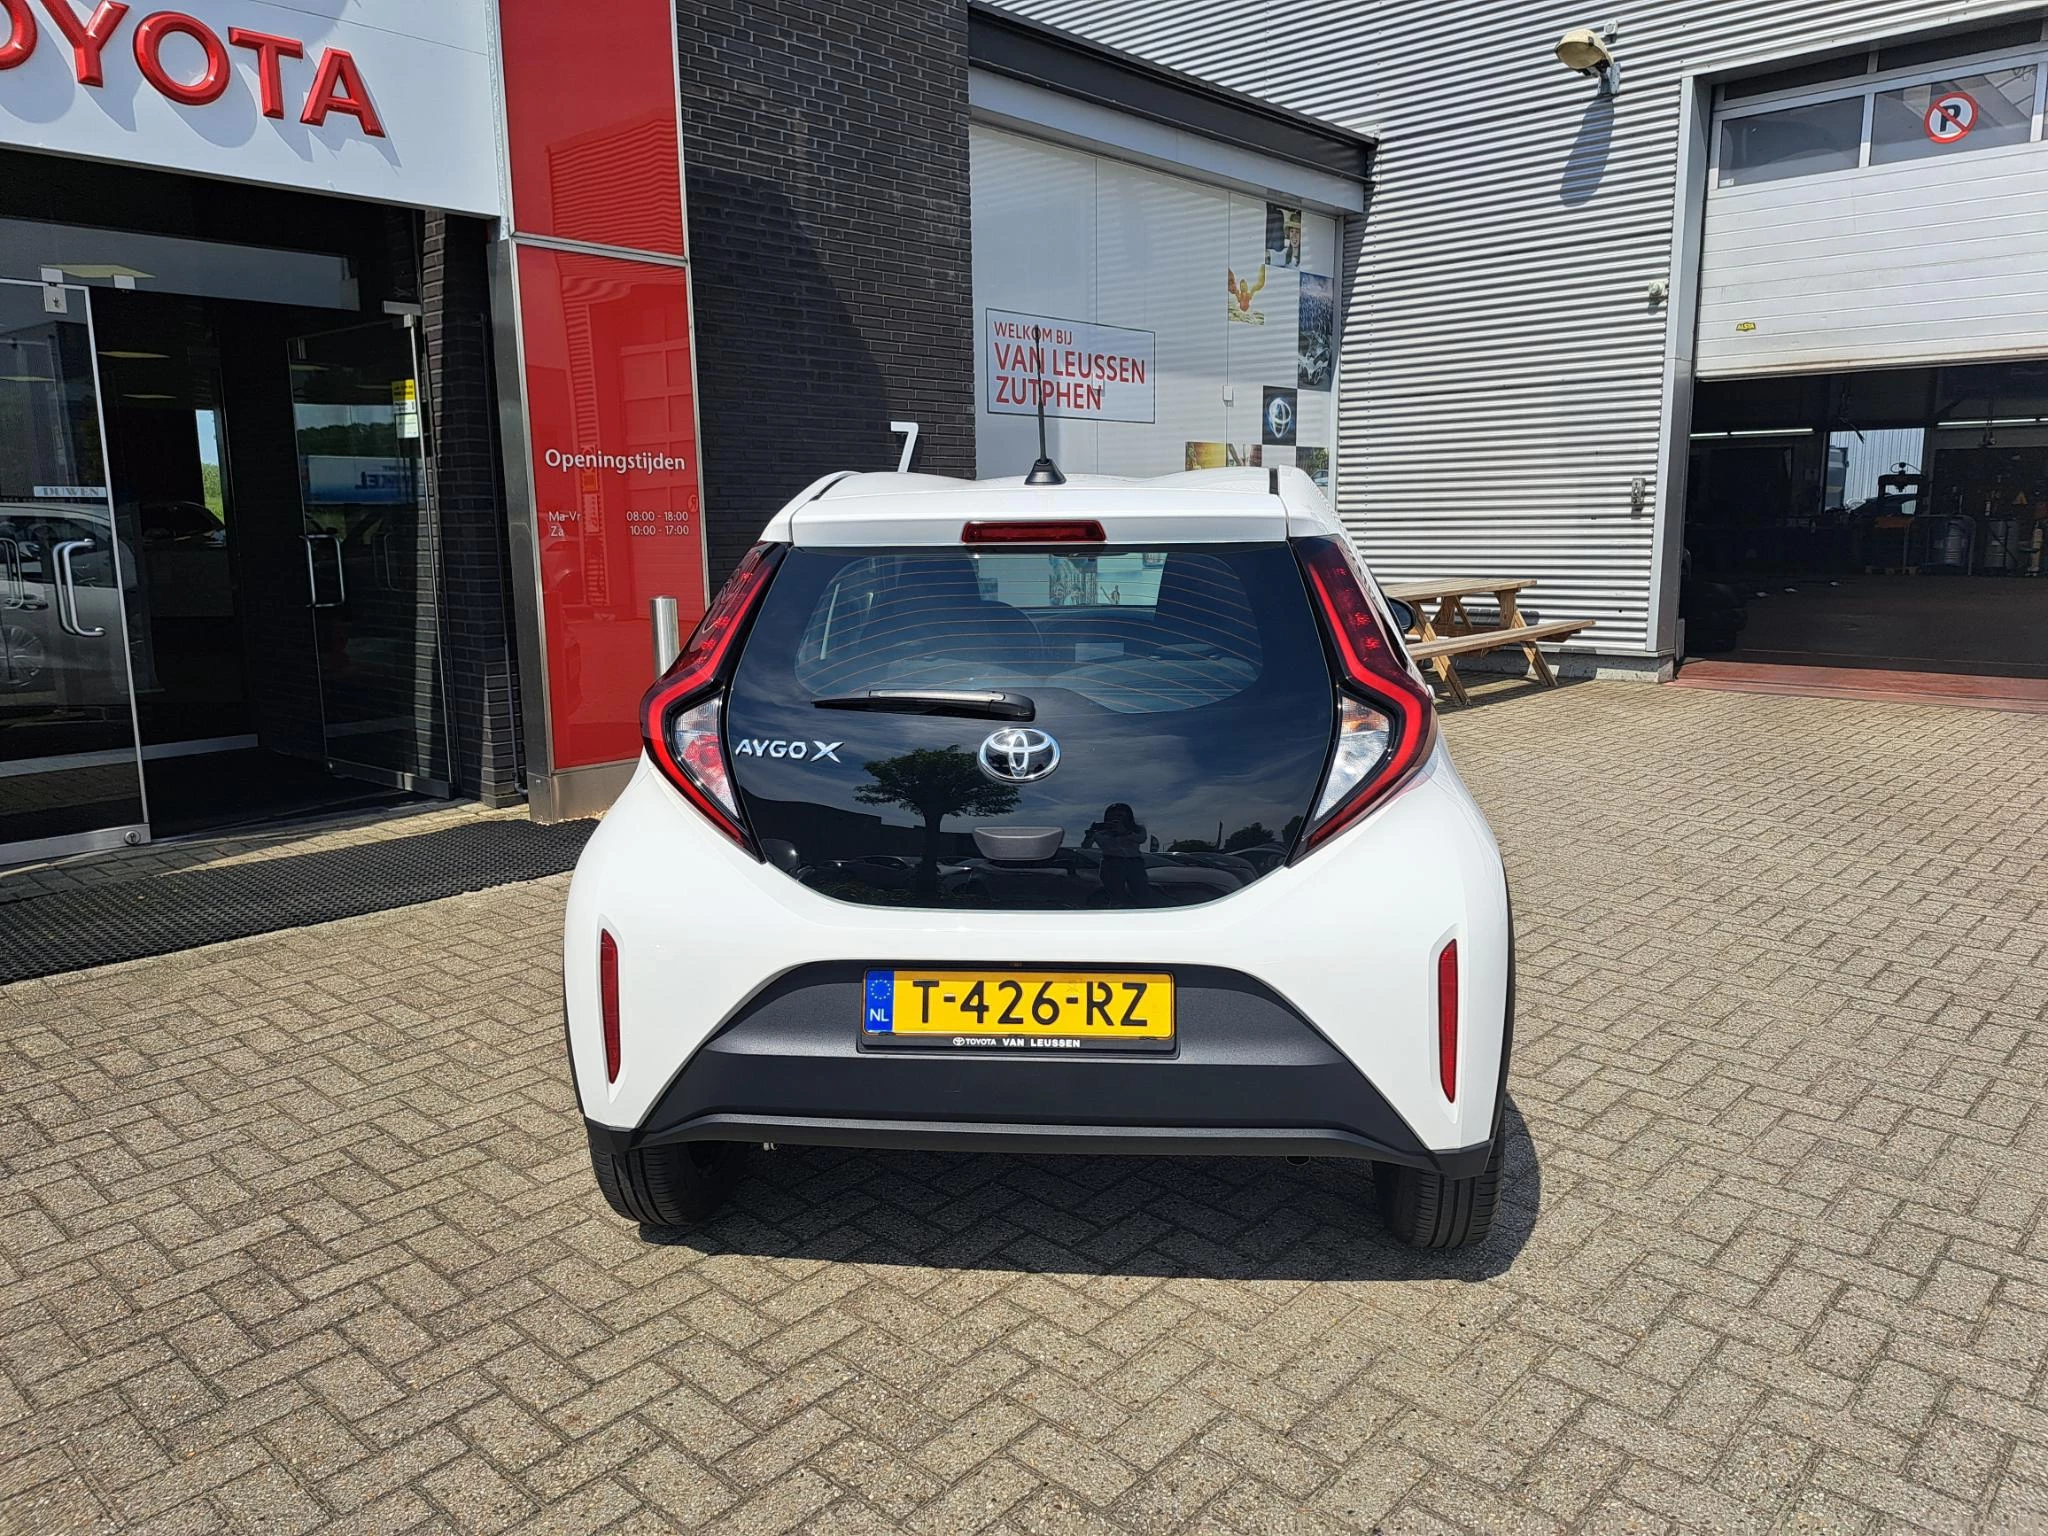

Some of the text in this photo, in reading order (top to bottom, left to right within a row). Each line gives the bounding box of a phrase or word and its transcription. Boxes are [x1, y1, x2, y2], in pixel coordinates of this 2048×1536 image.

[994, 320, 1073, 345] WELKOM BIJ
[994, 342, 1145, 384] VAN LEUSSEN
[995, 375, 1101, 411] ZUTPHEN
[890, 420, 919, 473] 7
[545, 448, 686, 474] Openingstijden
[548, 511, 581, 522] Ma-Vr
[626, 511, 655, 521] 08:00
[664, 511, 689, 521] 18:00
[550, 526, 565, 537] Za
[630, 525, 656, 535] 10:00
[664, 525, 689, 536] 17:00
[735, 739, 845, 763] AYGO X
[869, 1007, 890, 1022] NL
[912, 979, 1148, 1027] T-426-RZ
[965, 1038, 1081, 1048] TOYOTA VAN LEUSSEN
